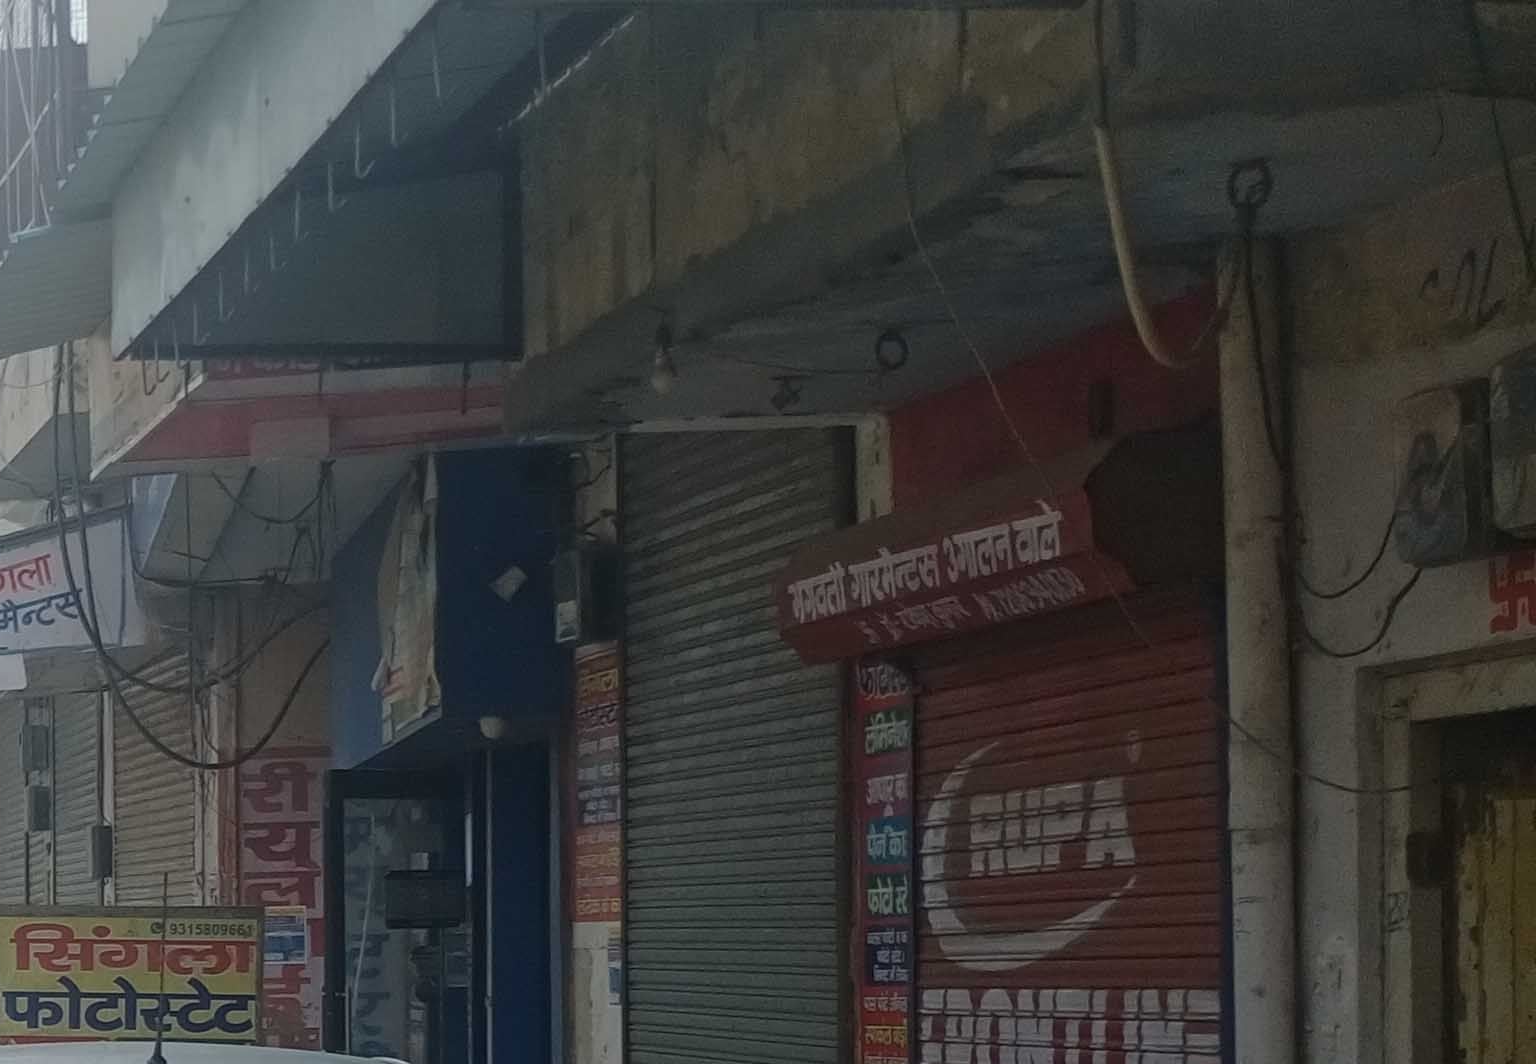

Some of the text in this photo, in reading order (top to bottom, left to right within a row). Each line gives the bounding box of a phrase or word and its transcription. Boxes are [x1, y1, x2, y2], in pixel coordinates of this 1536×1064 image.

[968, 776, 1138, 879] RUPA
[9, 922, 257, 977] सिंगला
[1, 976, 257, 1034] फोटोस्टेट
